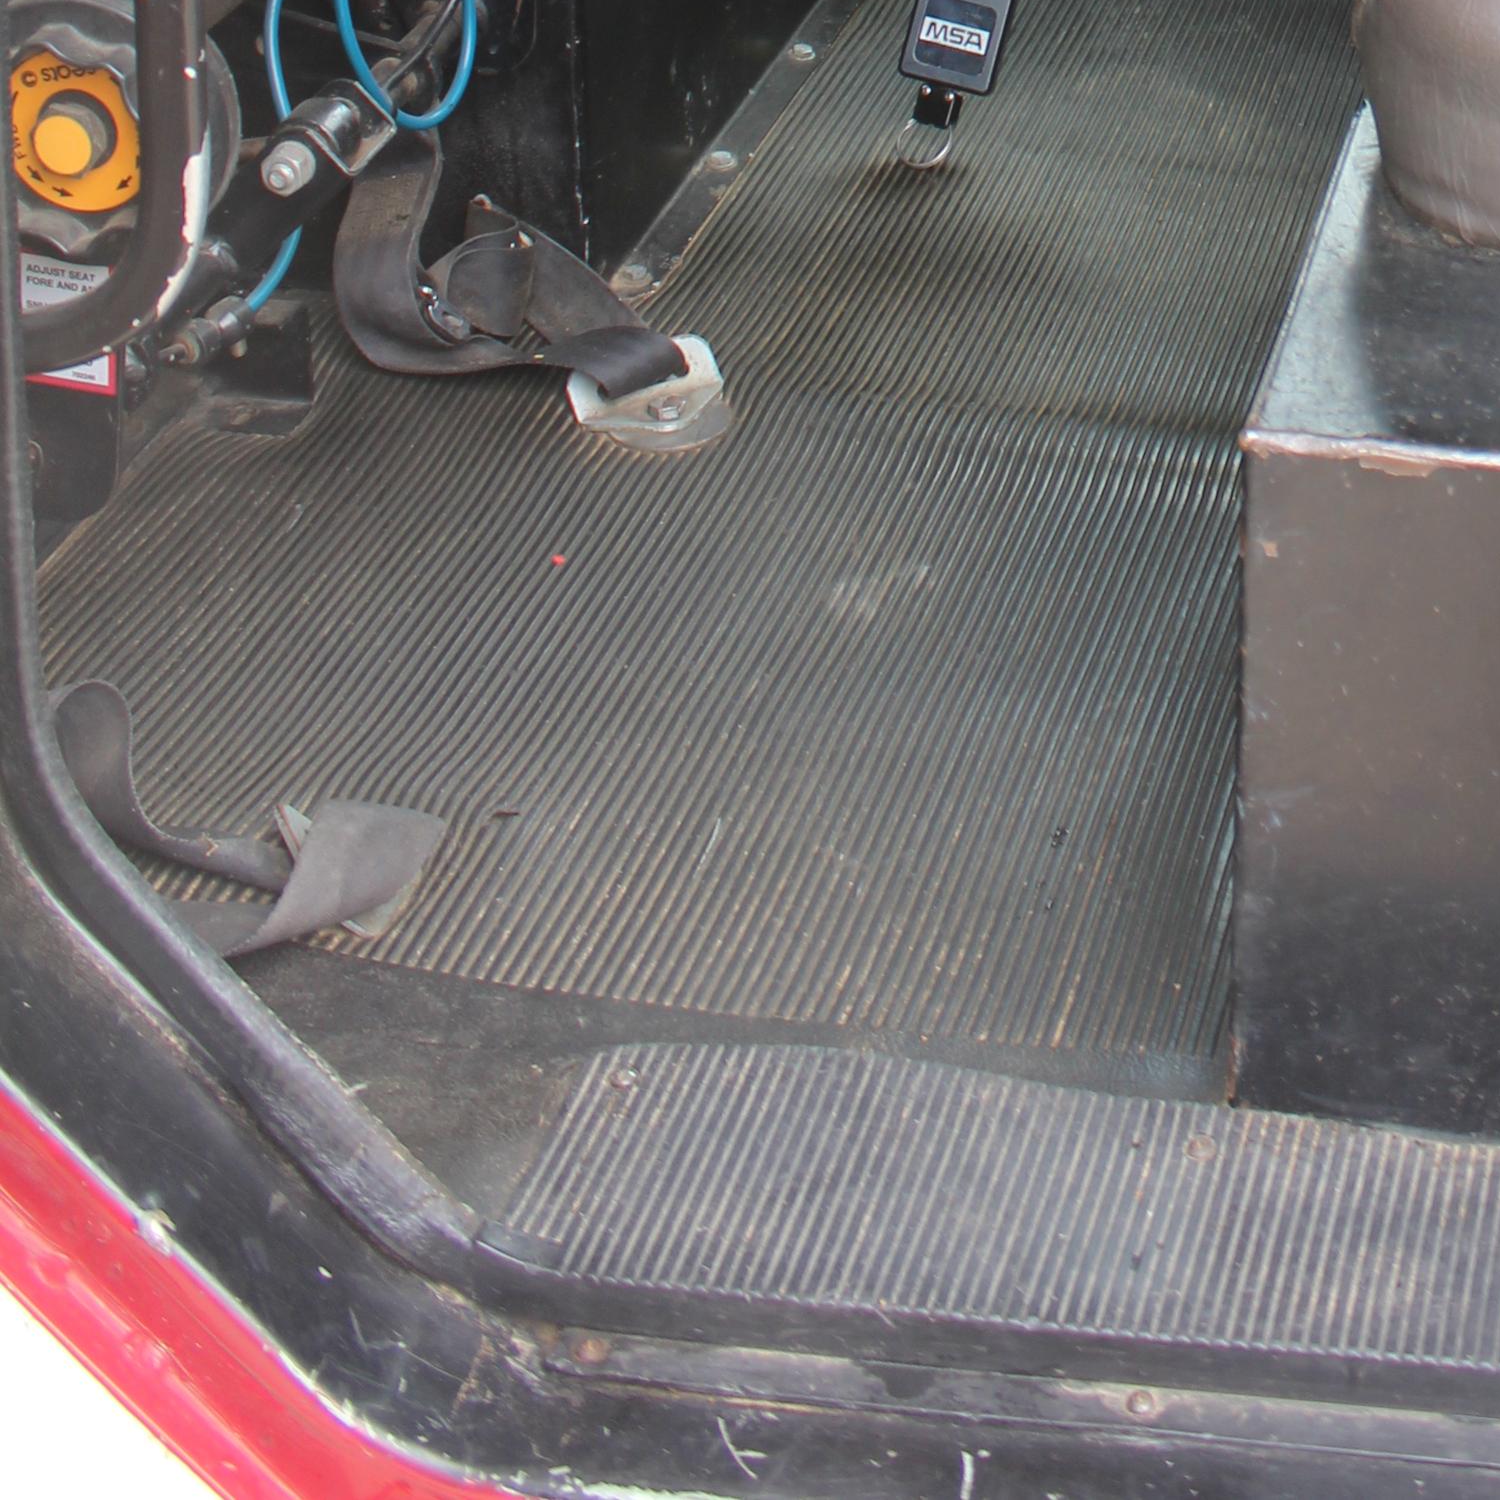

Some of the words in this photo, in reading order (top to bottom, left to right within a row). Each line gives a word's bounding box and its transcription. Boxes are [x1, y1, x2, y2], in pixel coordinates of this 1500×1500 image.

[925, 22, 984, 51] MSA
[26, 263, 65, 277] ADJUST
[68, 270, 95, 282] SEAT
[26, 275, 54, 288] FORE
[57, 281, 79, 292] AND
